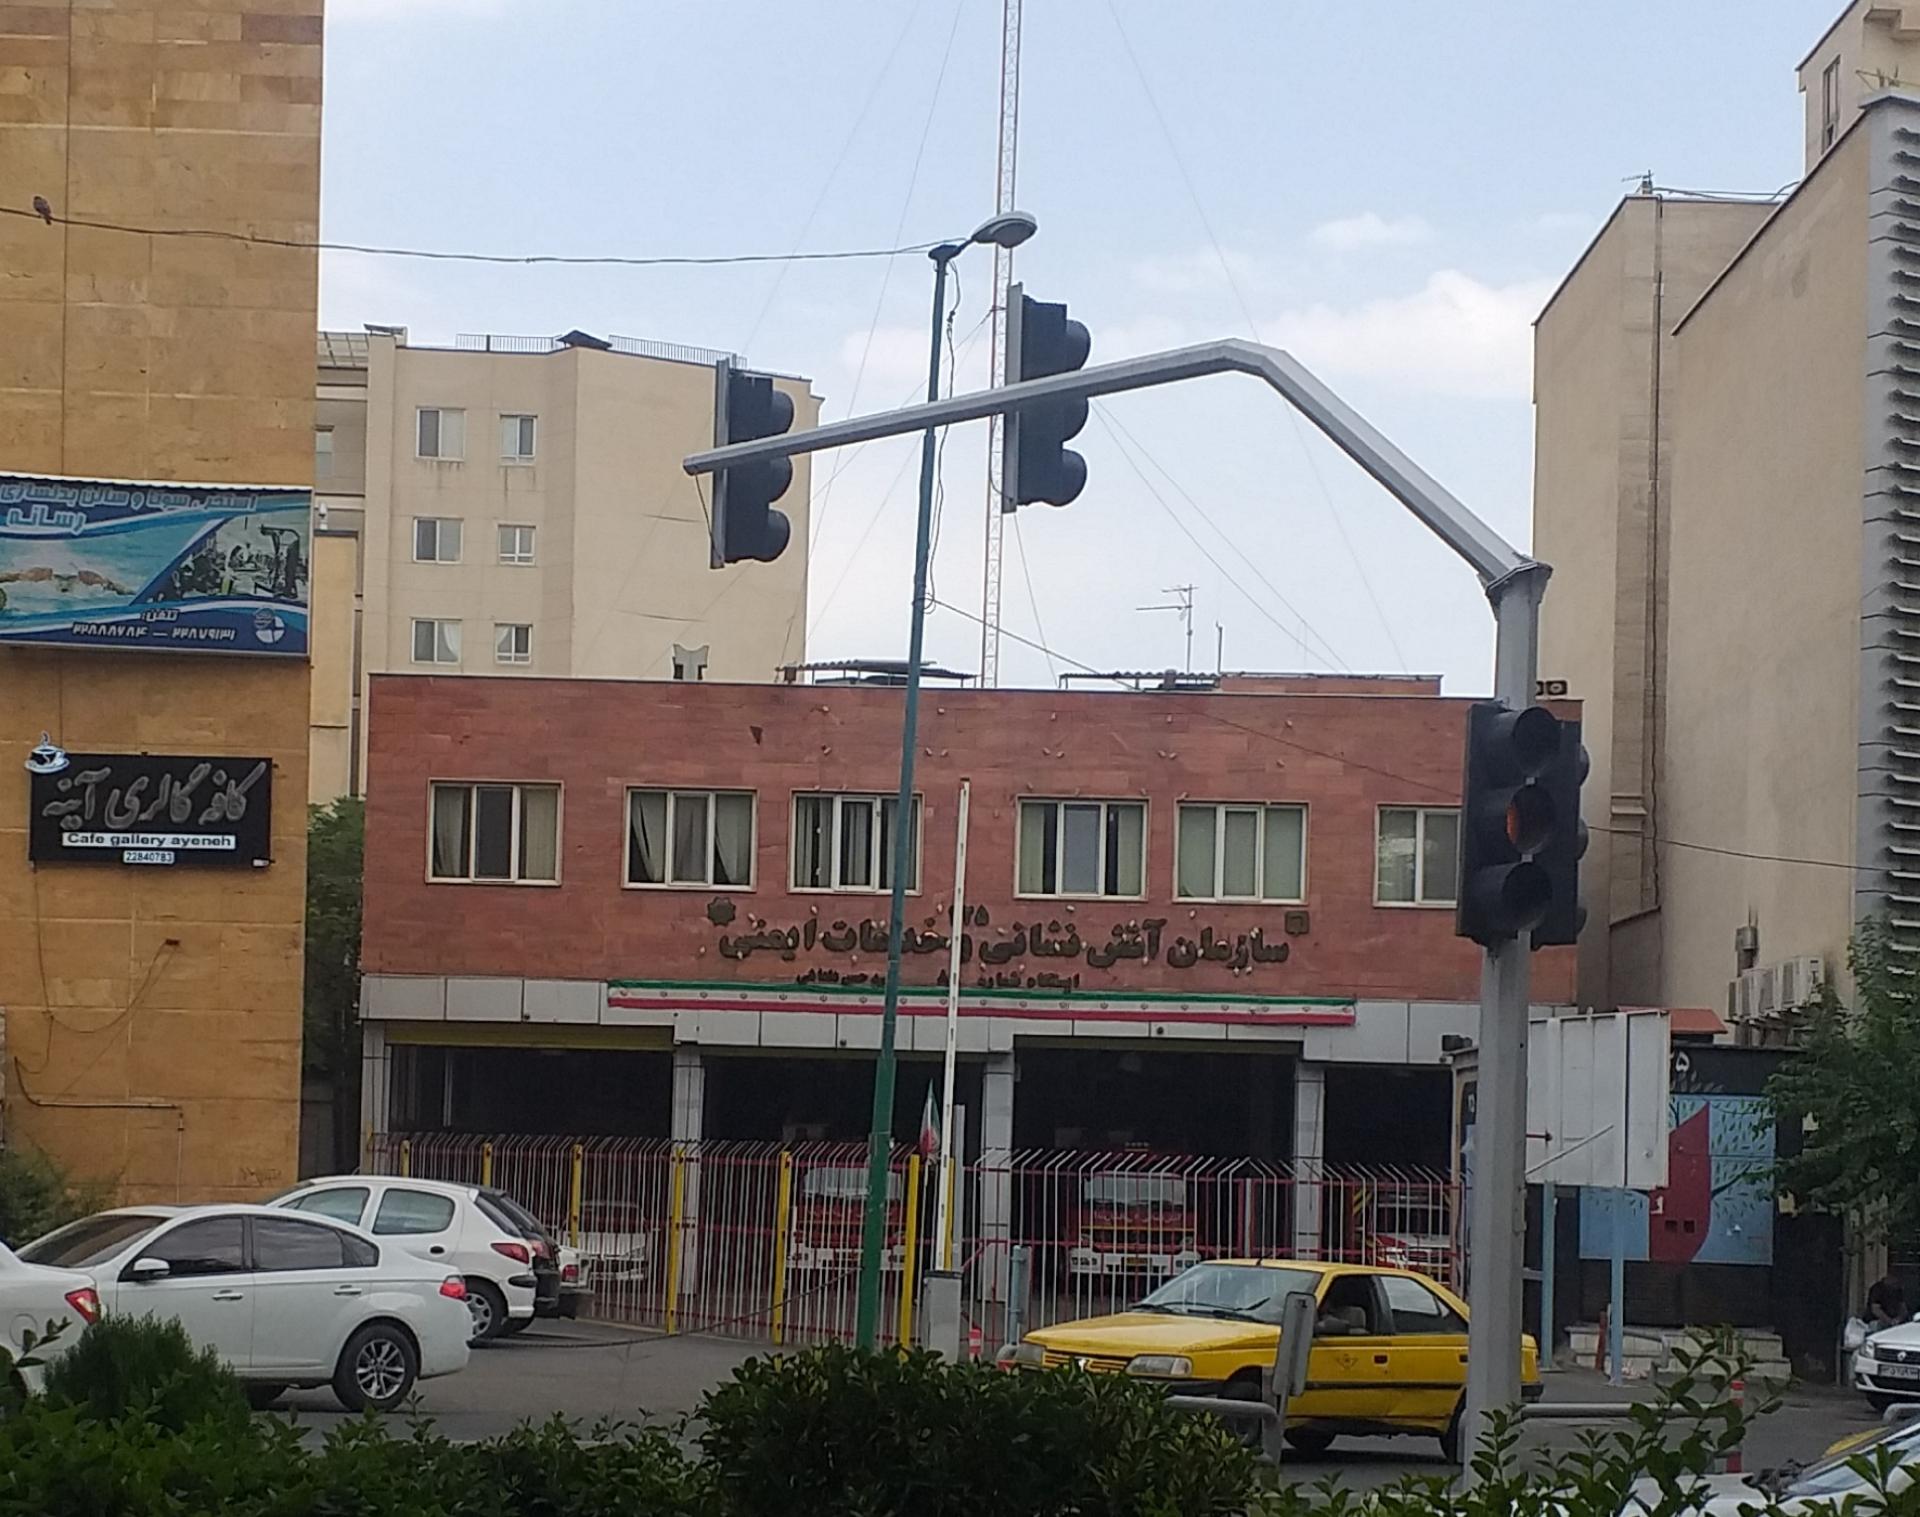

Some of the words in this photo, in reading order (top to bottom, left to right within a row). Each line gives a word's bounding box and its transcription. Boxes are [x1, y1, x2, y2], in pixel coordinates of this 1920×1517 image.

[79, 486, 129, 507] سالن
[130, 491, 145, 510] و
[146, 489, 191, 511] سونا
[104, 762, 211, 829] گالری
[198, 761, 267, 825] کافه
[67, 833, 105, 844] Cafe
[110, 834, 166, 846] gallery
[171, 835, 231, 847] ayeneh
[1167, 926, 1289, 969] سازمان
